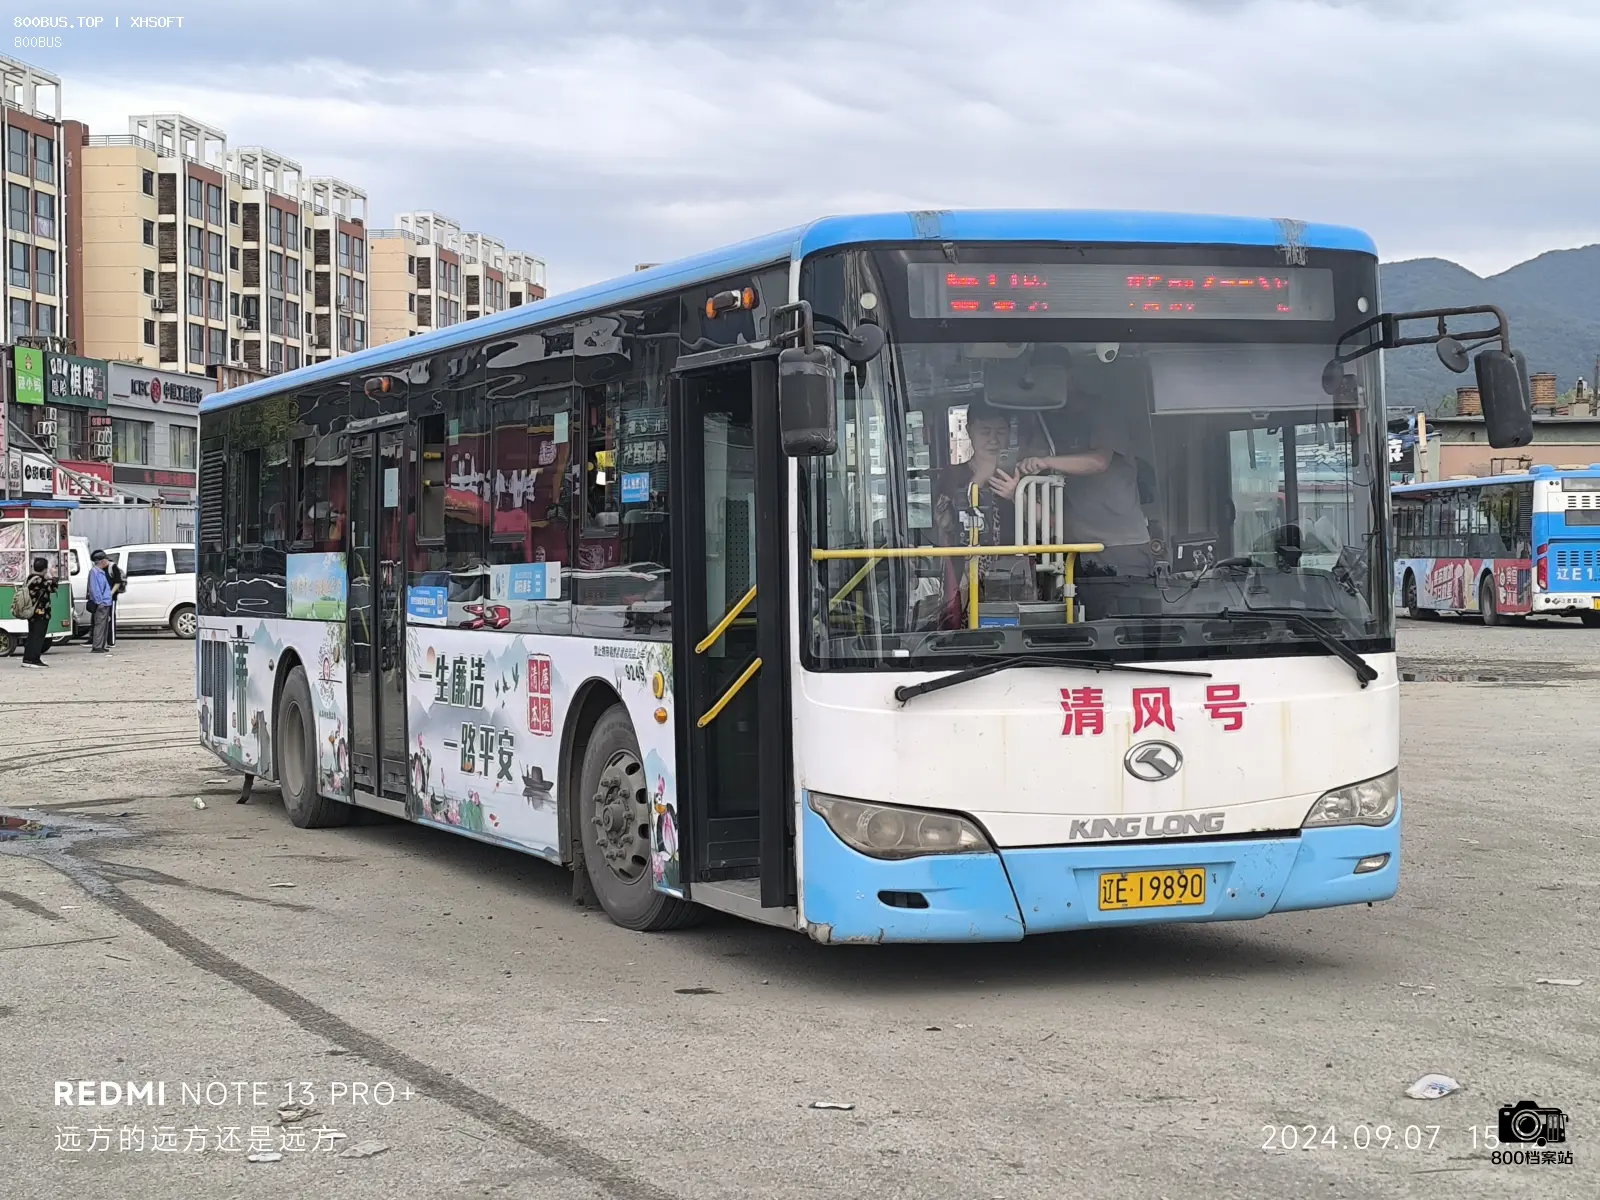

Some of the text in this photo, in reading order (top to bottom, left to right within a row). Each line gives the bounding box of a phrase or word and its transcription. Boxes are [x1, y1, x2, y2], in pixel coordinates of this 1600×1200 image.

[70, 363, 94, 398] 棋牌
[131, 378, 150, 397] ICBC
[163, 381, 203, 404] 中国工商银行
[418, 654, 486, 709] 一生廉洁
[625, 663, 645, 681] 9249
[1059, 684, 1248, 736] 清风号
[443, 721, 516, 784] 一路平安
[1069, 812, 1226, 840] KING LONG
